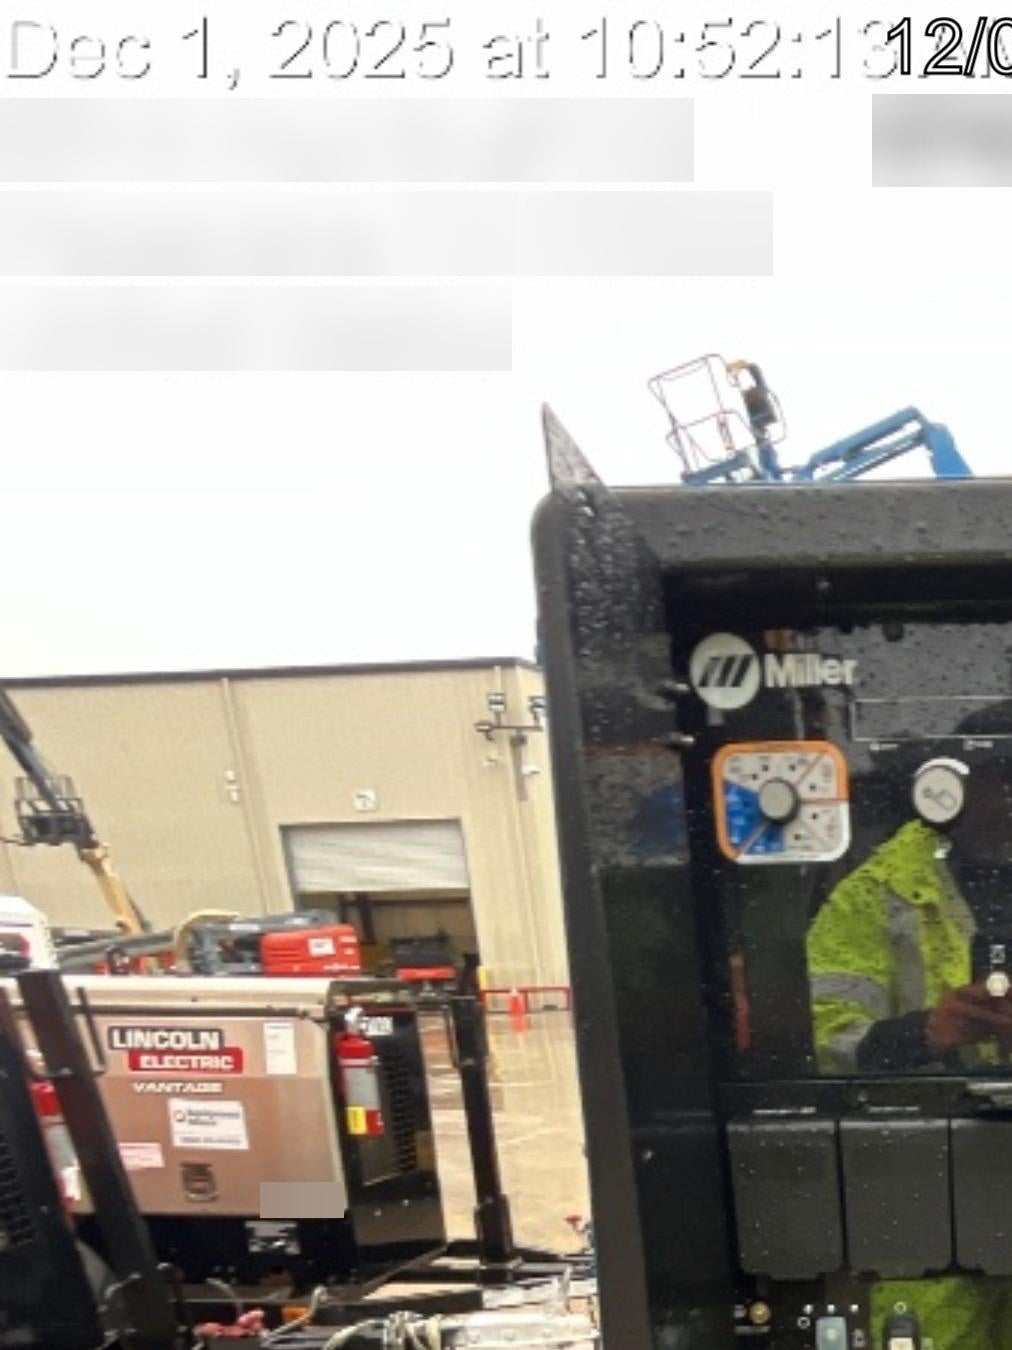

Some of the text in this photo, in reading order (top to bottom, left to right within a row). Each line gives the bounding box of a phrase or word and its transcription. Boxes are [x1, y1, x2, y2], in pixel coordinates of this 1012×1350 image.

[764, 653, 858, 688] Miller
[112, 1028, 220, 1050] LINCOLN
[139, 1054, 235, 1070] ELECTRIC
[132, 1082, 223, 1094] VANTAGE
